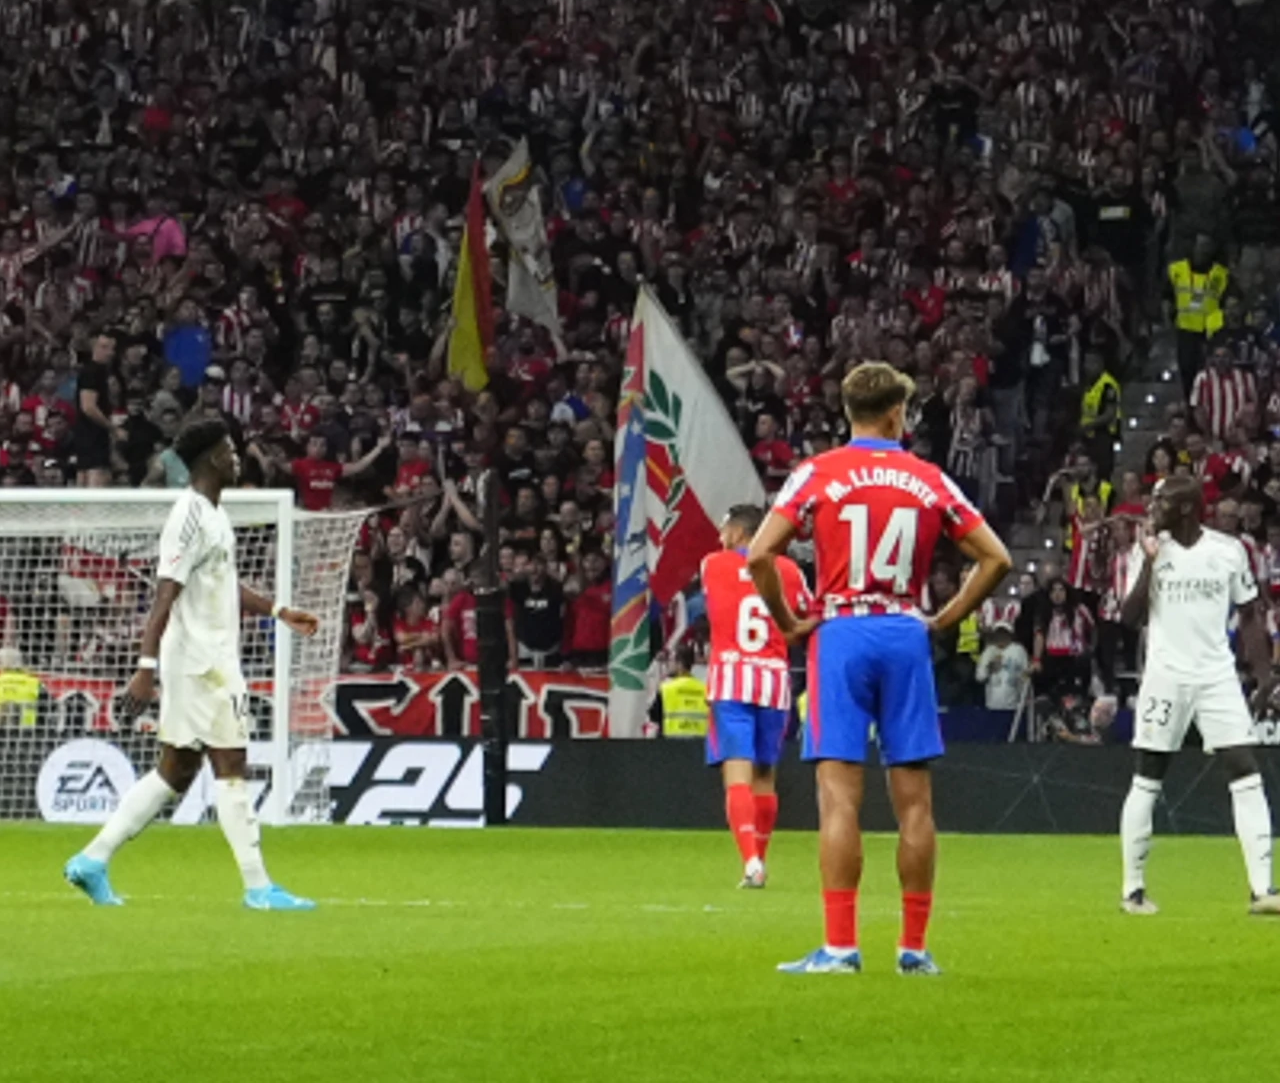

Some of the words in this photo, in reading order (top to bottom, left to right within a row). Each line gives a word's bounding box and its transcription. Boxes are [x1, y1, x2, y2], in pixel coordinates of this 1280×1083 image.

[824, 480, 852, 503] M.
[848, 468, 938, 508] LLORENTE
[838, 503, 918, 595] 14
[736, 594, 771, 653] 6
[1143, 696, 1172, 727] 23
[56, 762, 119, 794] EA
